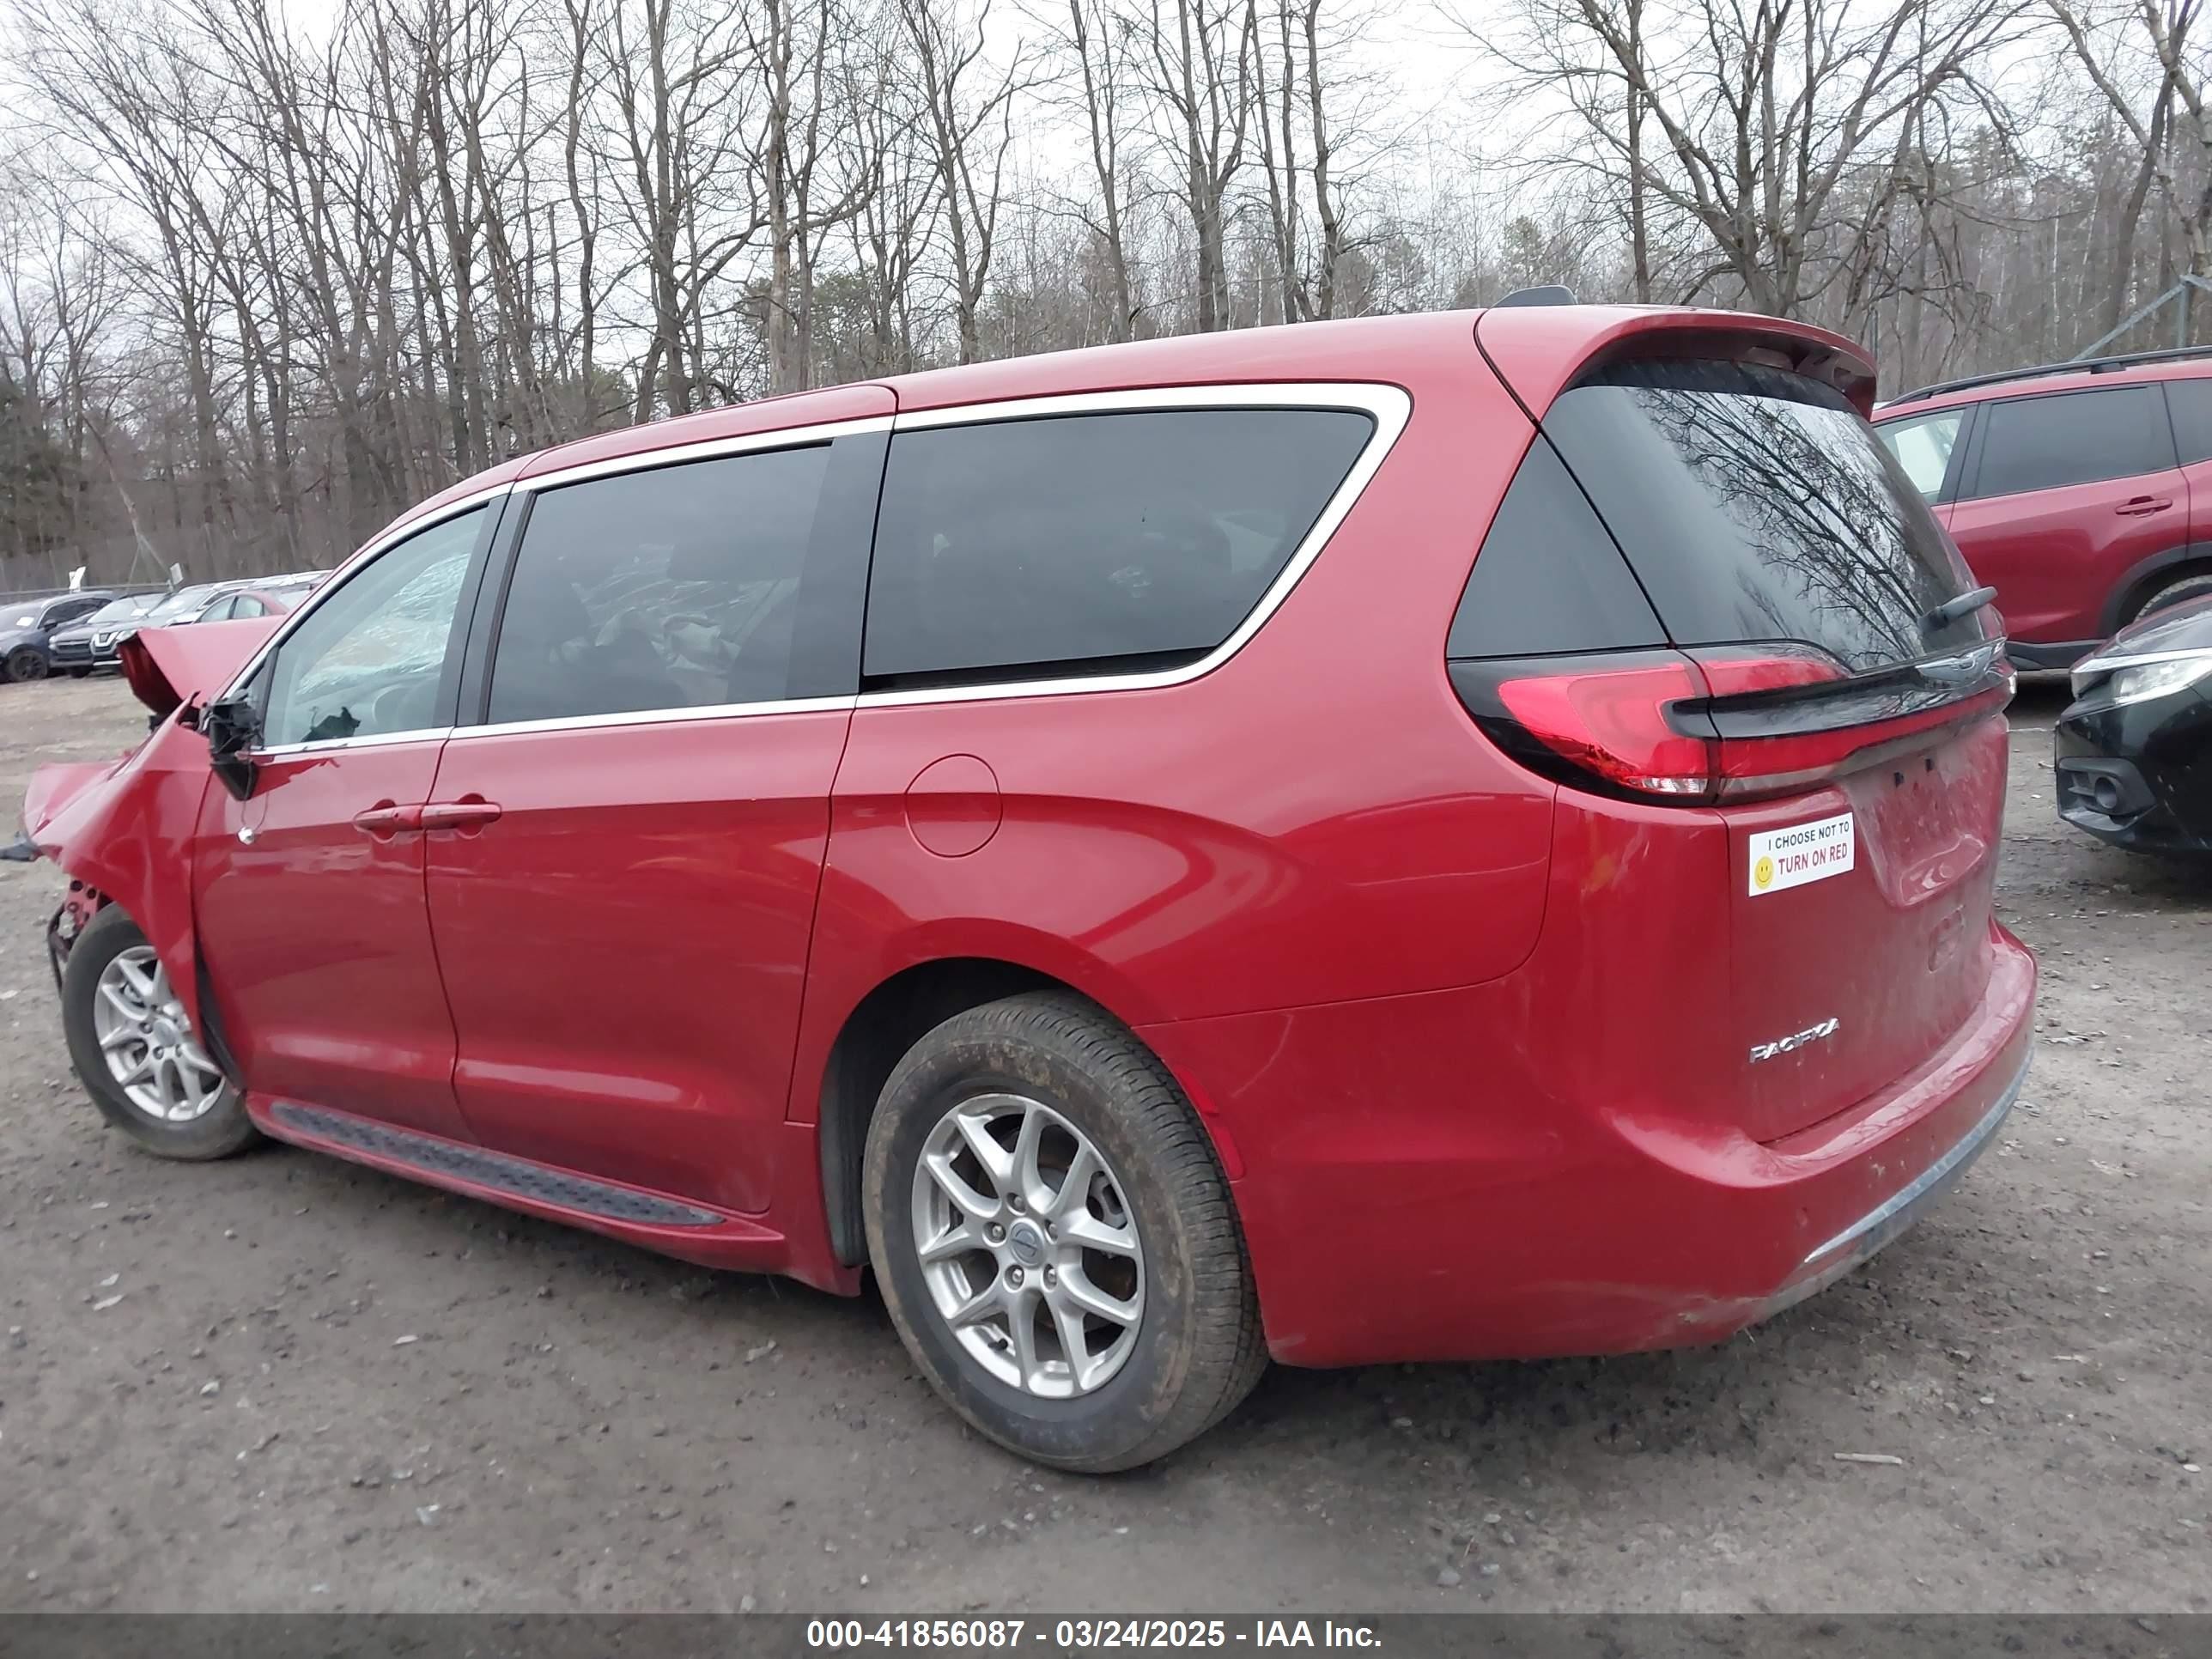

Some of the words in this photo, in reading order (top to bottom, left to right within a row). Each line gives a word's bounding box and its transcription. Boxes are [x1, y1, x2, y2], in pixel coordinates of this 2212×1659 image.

[1775, 830, 1815, 849] CHOOSE
[1819, 823, 1837, 839] NOT
[1839, 821, 1850, 834] TO
[1778, 852, 1809, 875] TURN
[1813, 847, 1826, 866] ON
[1830, 842, 1848, 862] RED
